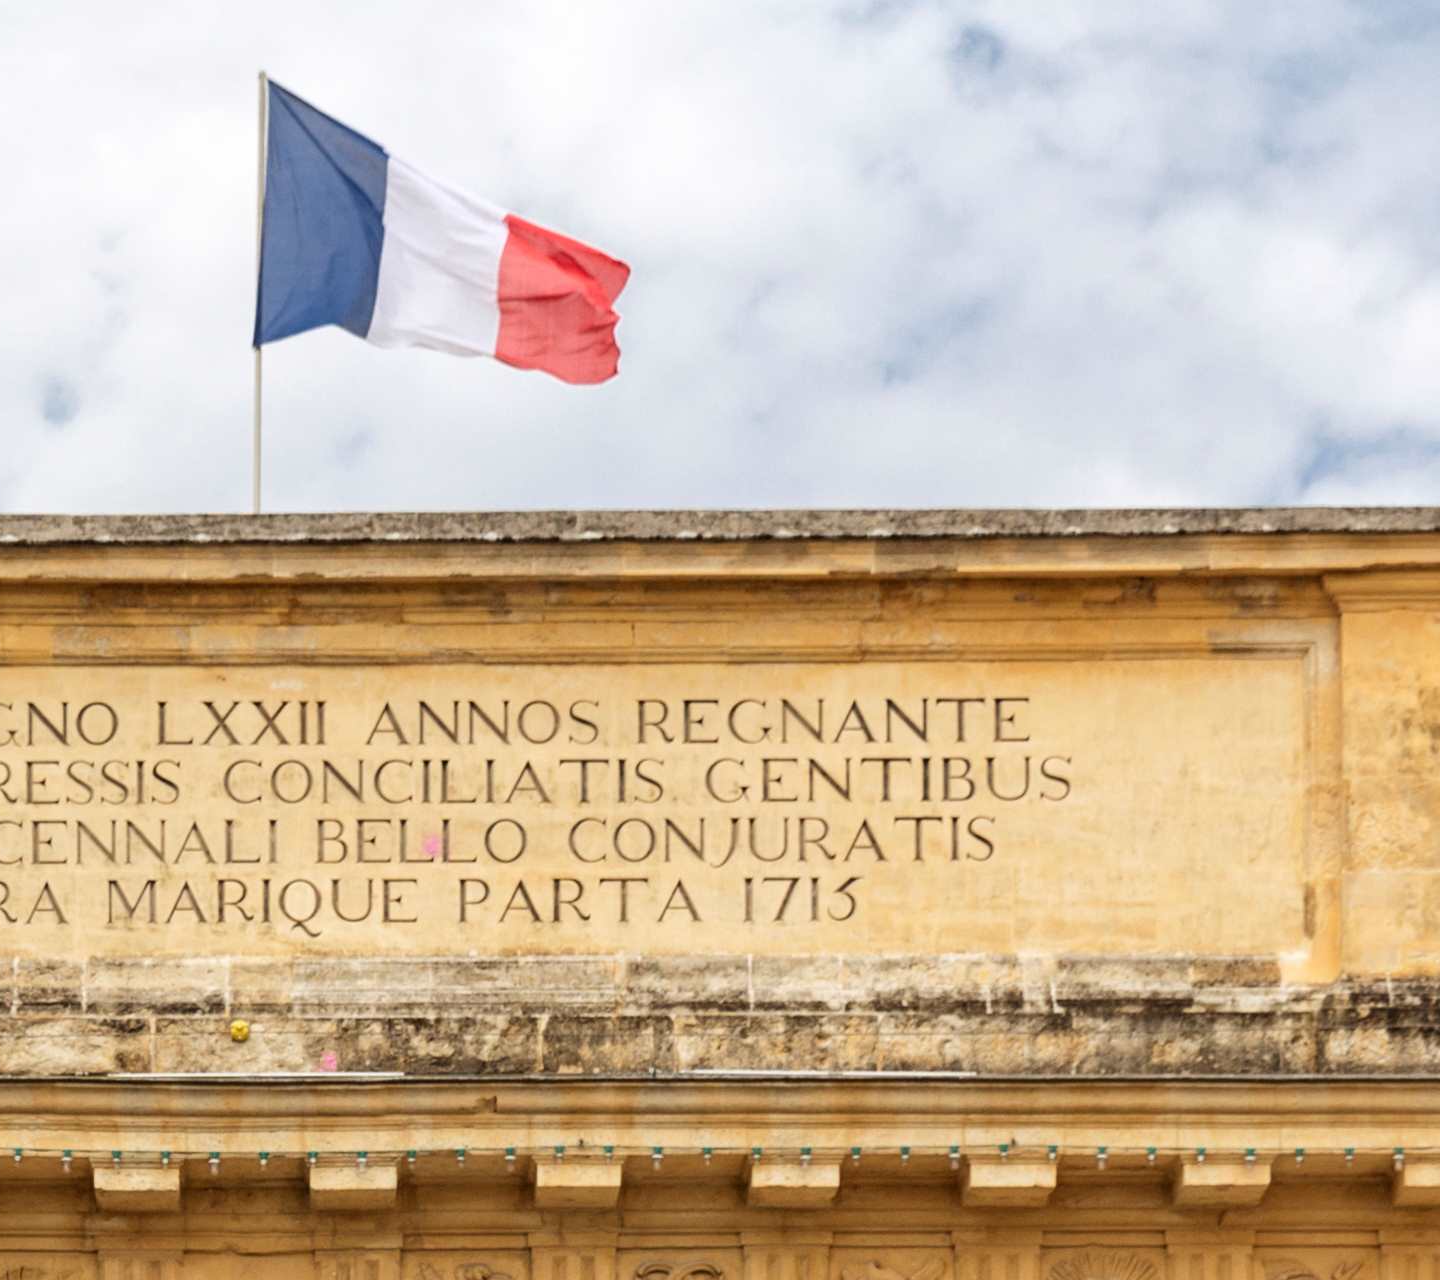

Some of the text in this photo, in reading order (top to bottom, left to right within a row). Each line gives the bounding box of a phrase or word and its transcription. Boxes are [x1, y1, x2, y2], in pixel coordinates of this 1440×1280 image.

[157, 700, 327, 746] LXXII
[365, 699, 600, 746] ANNOS
[636, 696, 1031, 745] REGNANTE
[222, 758, 664, 805] CONCILIATIS
[704, 756, 1072, 804] GENTIBUS
[315, 818, 528, 864] BELLO
[567, 815, 995, 868] CONJURATIS
[107, 878, 418, 938] MARIQUE
[458, 877, 702, 924] PARTA
[743, 876, 862, 923] 1715
